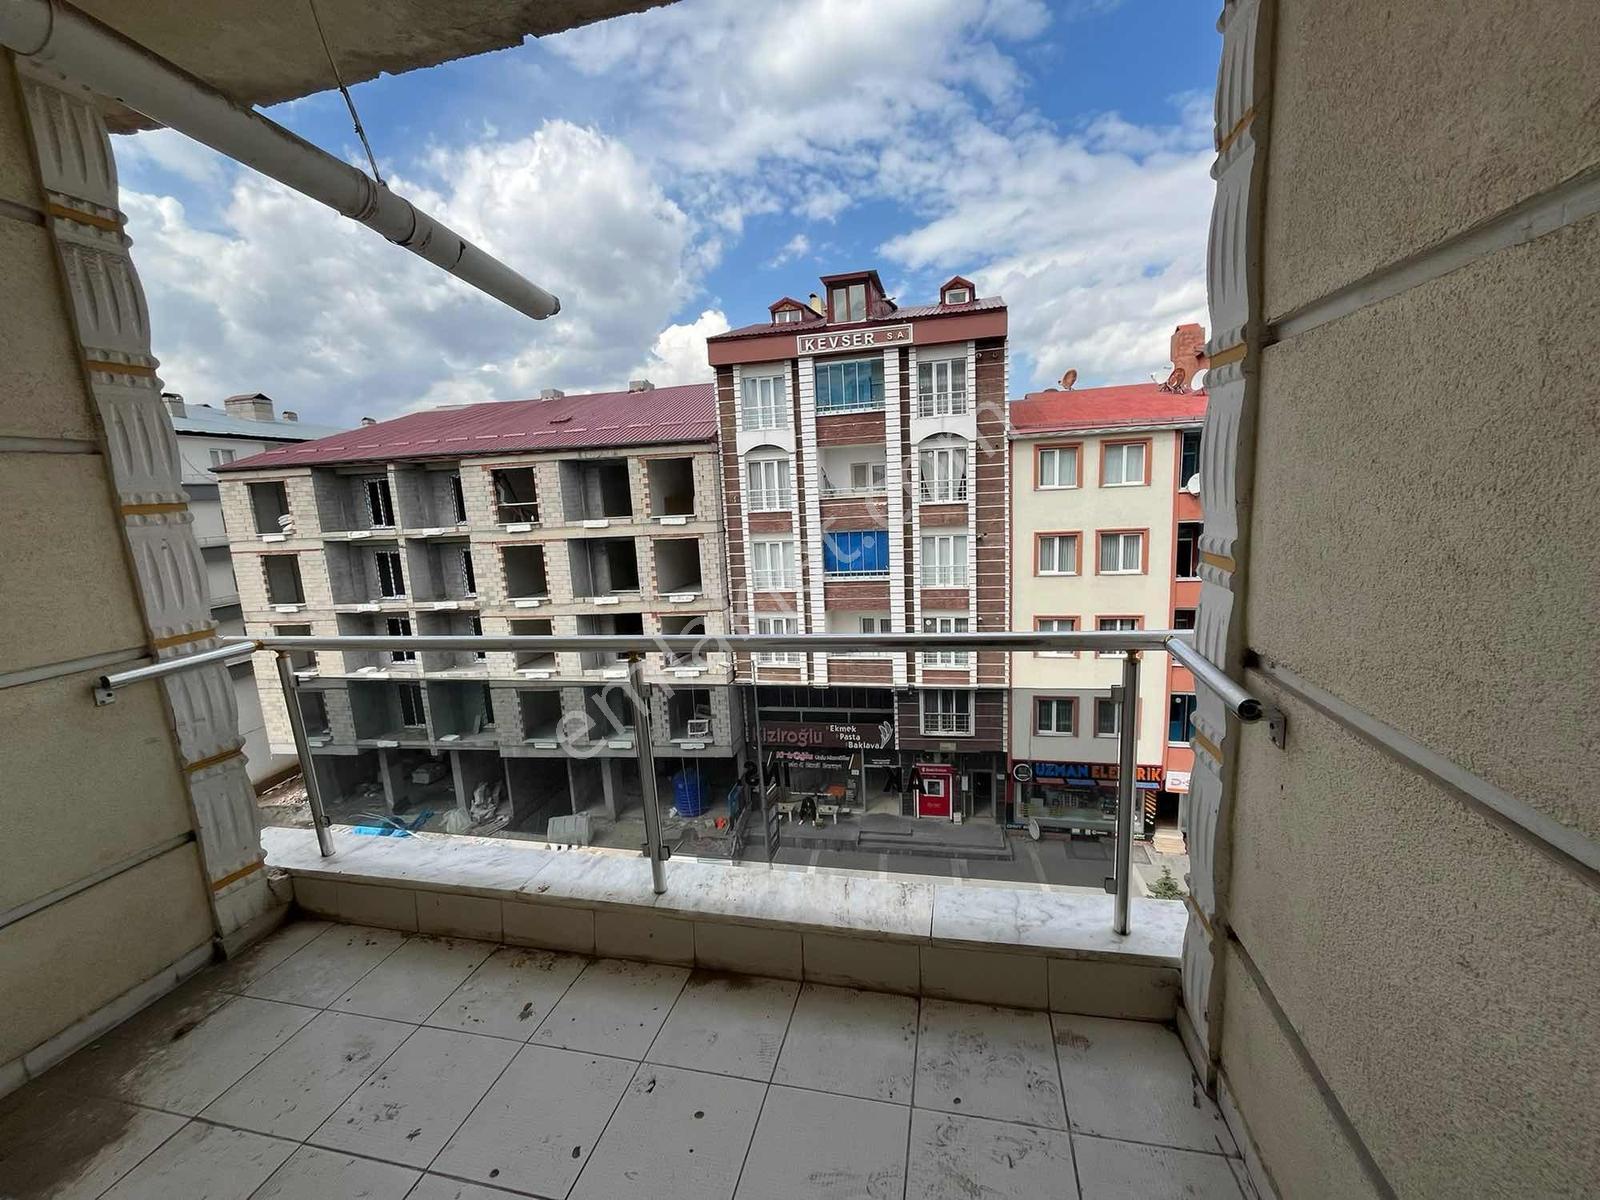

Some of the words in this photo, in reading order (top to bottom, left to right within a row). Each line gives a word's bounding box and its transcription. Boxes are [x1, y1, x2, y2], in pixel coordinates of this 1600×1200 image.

[804, 332, 875, 352] KEVSER
[830, 724, 857, 733] Ekmek
[839, 733, 861, 741] Pasta
[848, 741, 880, 749] Baklava
[1034, 762, 1089, 778] UZMAN
[1091, 765, 1162, 781] ELERİK
